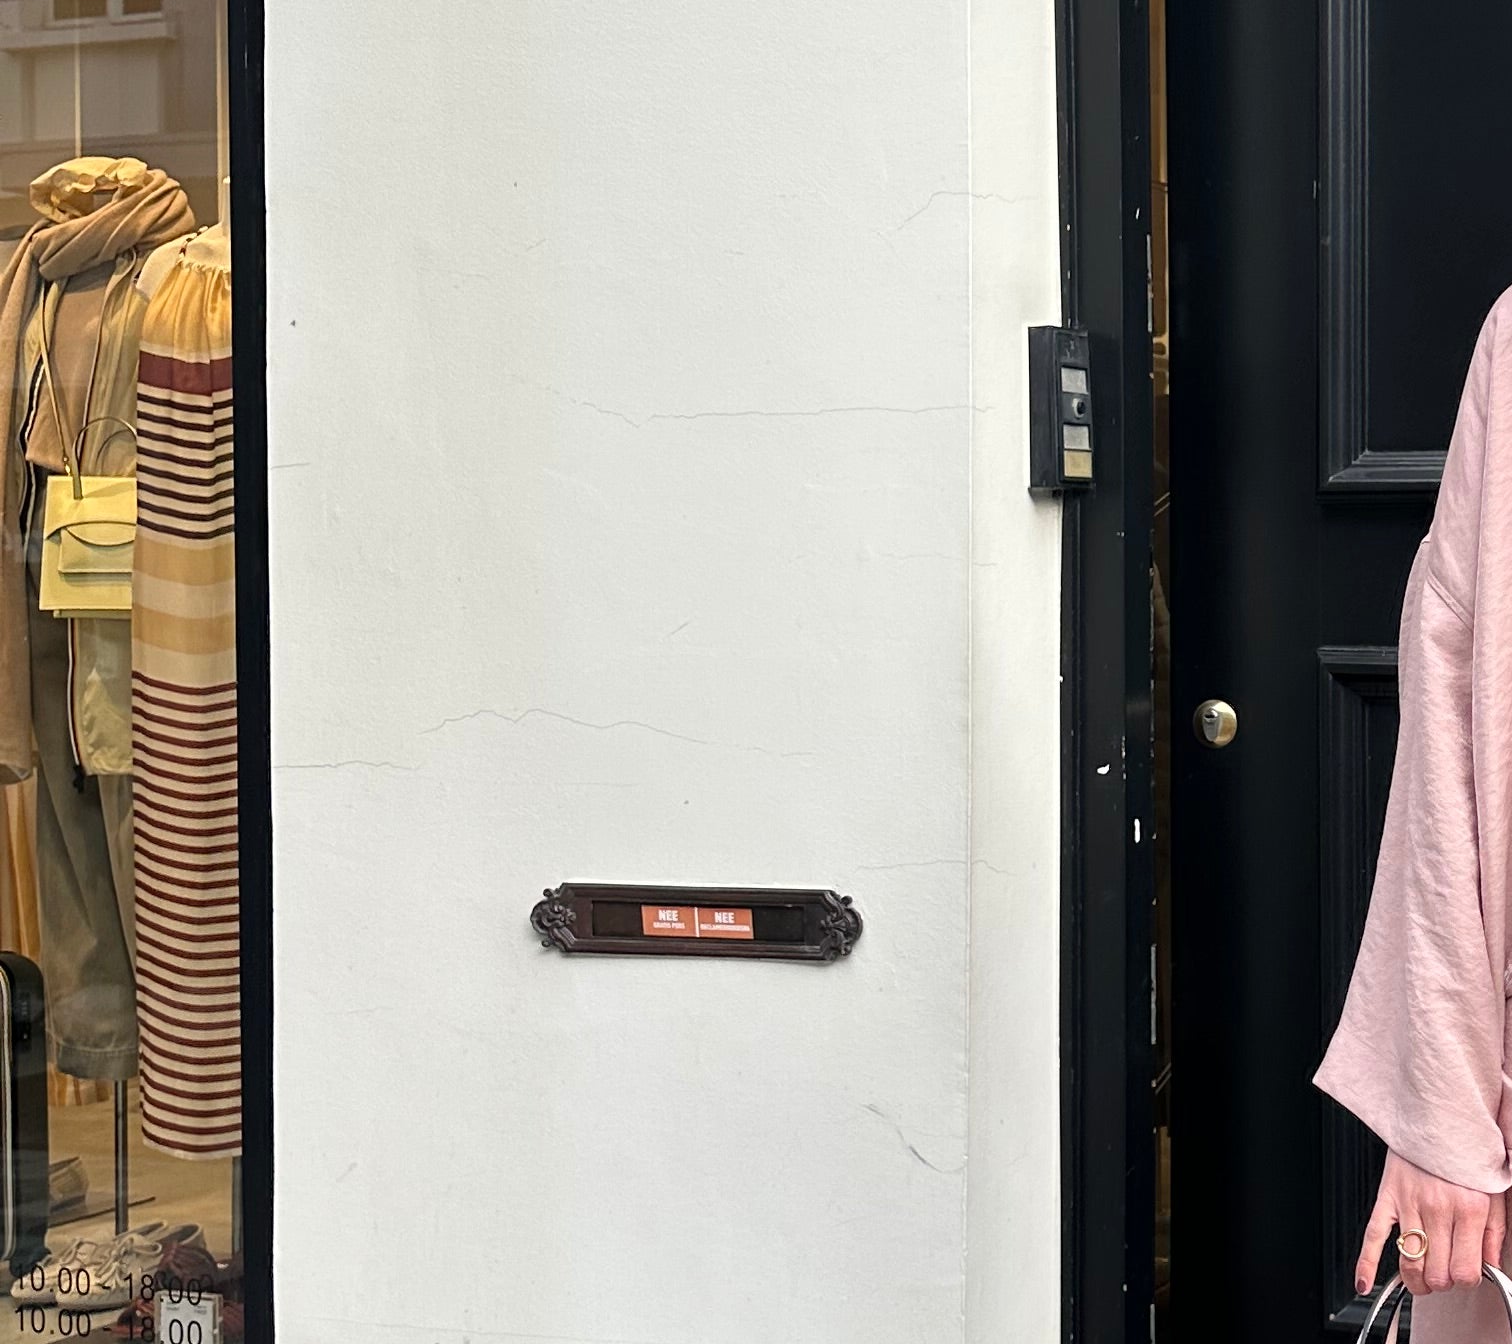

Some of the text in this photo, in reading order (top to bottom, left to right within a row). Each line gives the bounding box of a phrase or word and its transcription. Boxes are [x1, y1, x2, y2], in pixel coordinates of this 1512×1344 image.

[658, 909, 679, 922] NEE
[714, 911, 735, 924] NEE
[15, 1306, 91, 1337] 10.00
